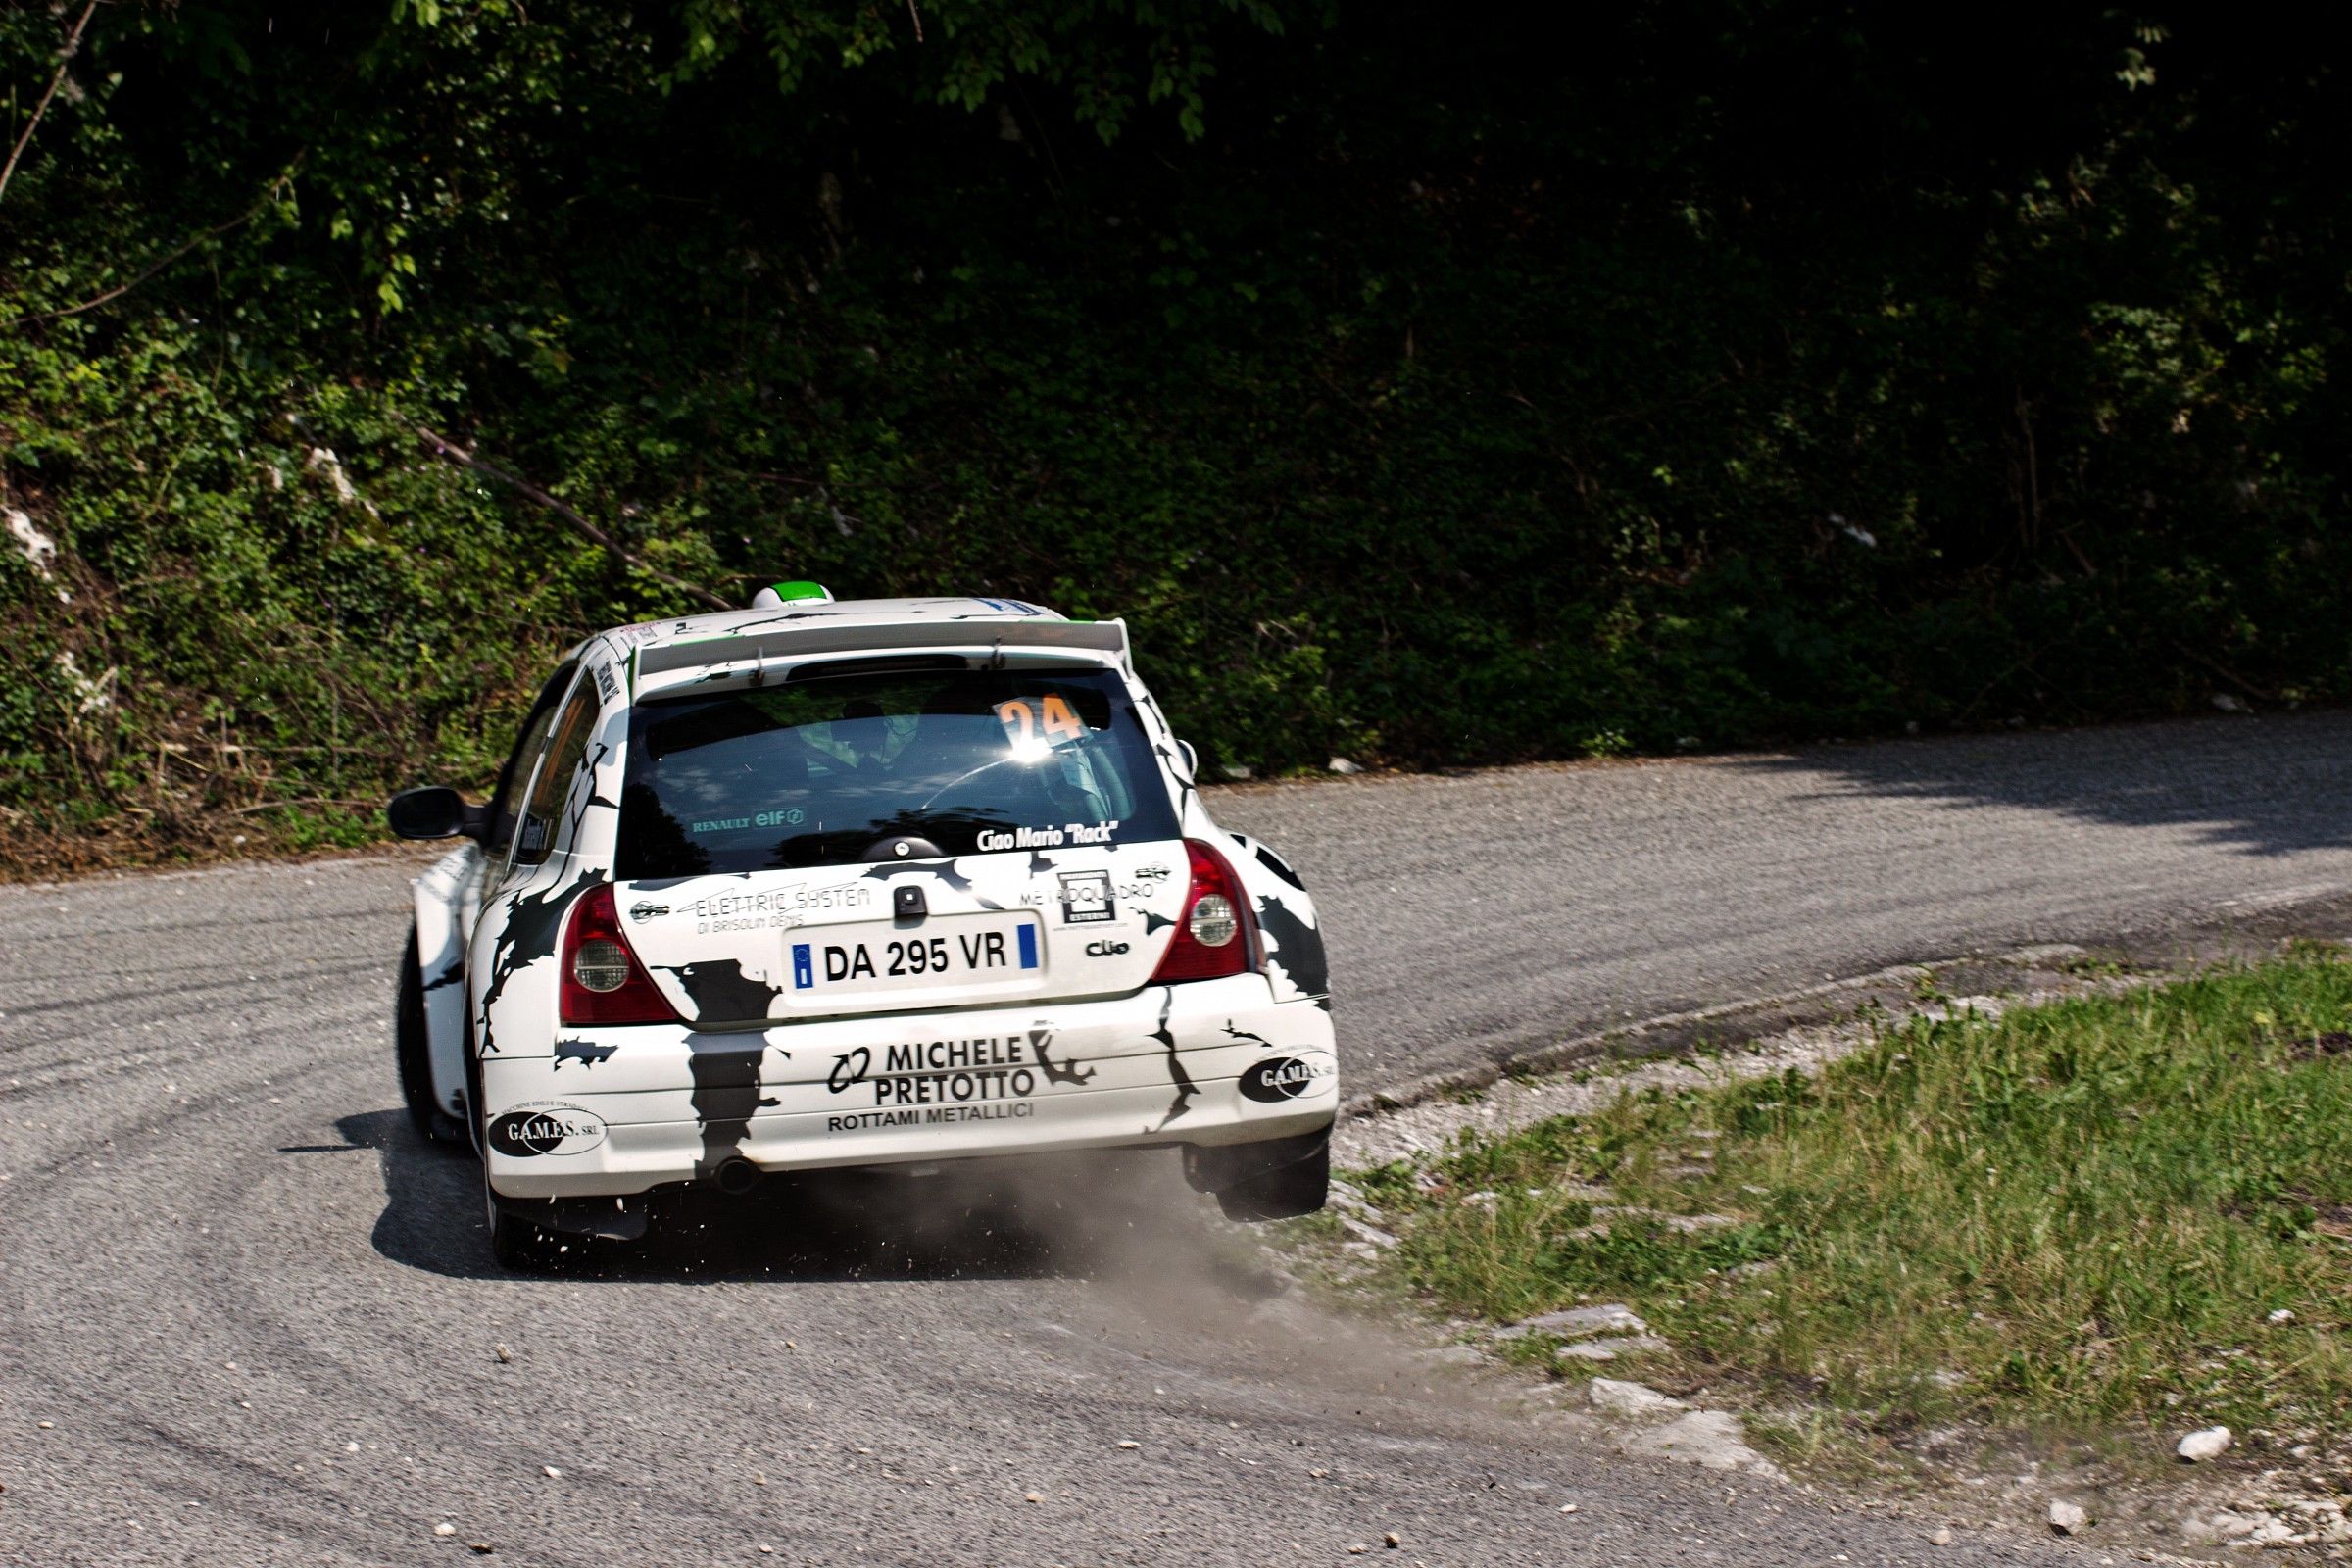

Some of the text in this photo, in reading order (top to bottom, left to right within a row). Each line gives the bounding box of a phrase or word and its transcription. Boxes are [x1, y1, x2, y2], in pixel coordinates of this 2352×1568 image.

[1000, 692, 1082, 757] 24
[693, 810, 785, 832] RENAULT elf
[977, 830, 1015, 851] Ciao
[1015, 825, 1064, 848] Mario
[696, 888, 871, 918] ELETTRIC SYSTEM
[825, 943, 876, 981] DA
[887, 937, 949, 977] 295
[959, 931, 1007, 969] VR
[1085, 939, 1131, 957] Clio
[886, 1036, 1023, 1071] MICHELE
[875, 1069, 1034, 1105] PRETOTTO
[581, 1125, 600, 1136] SRL
[828, 1102, 1034, 1131] ROTTAMI METALLICI
